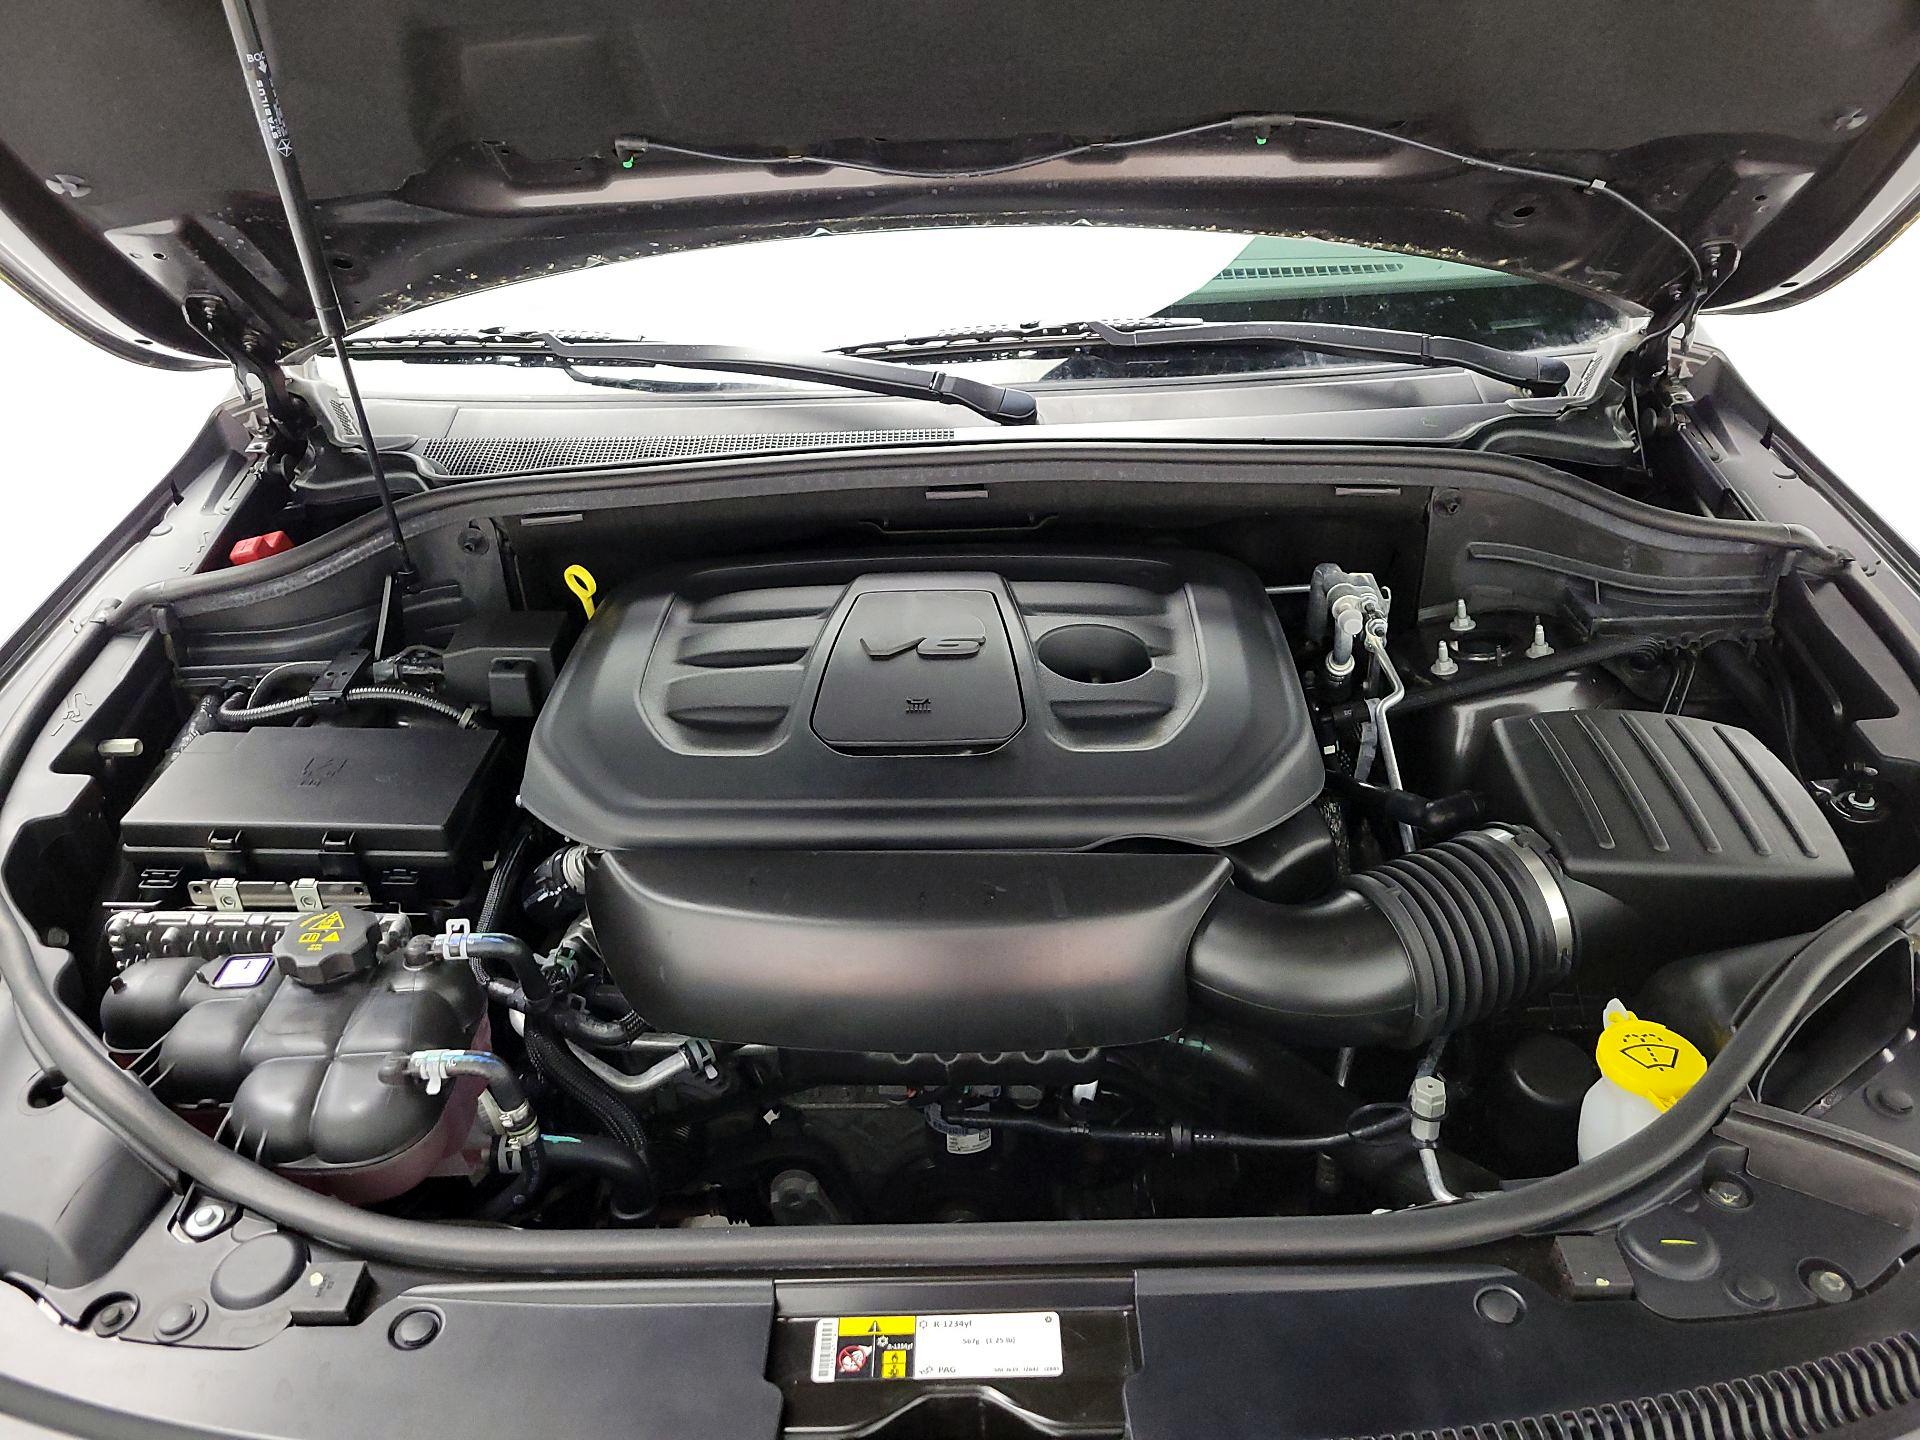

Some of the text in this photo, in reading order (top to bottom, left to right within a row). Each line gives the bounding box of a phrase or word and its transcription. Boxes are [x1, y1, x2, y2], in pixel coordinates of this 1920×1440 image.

[256, 80, 279, 139] STABILUS
[859, 630, 987, 661] V6
[938, 1366, 956, 1374] PAG
